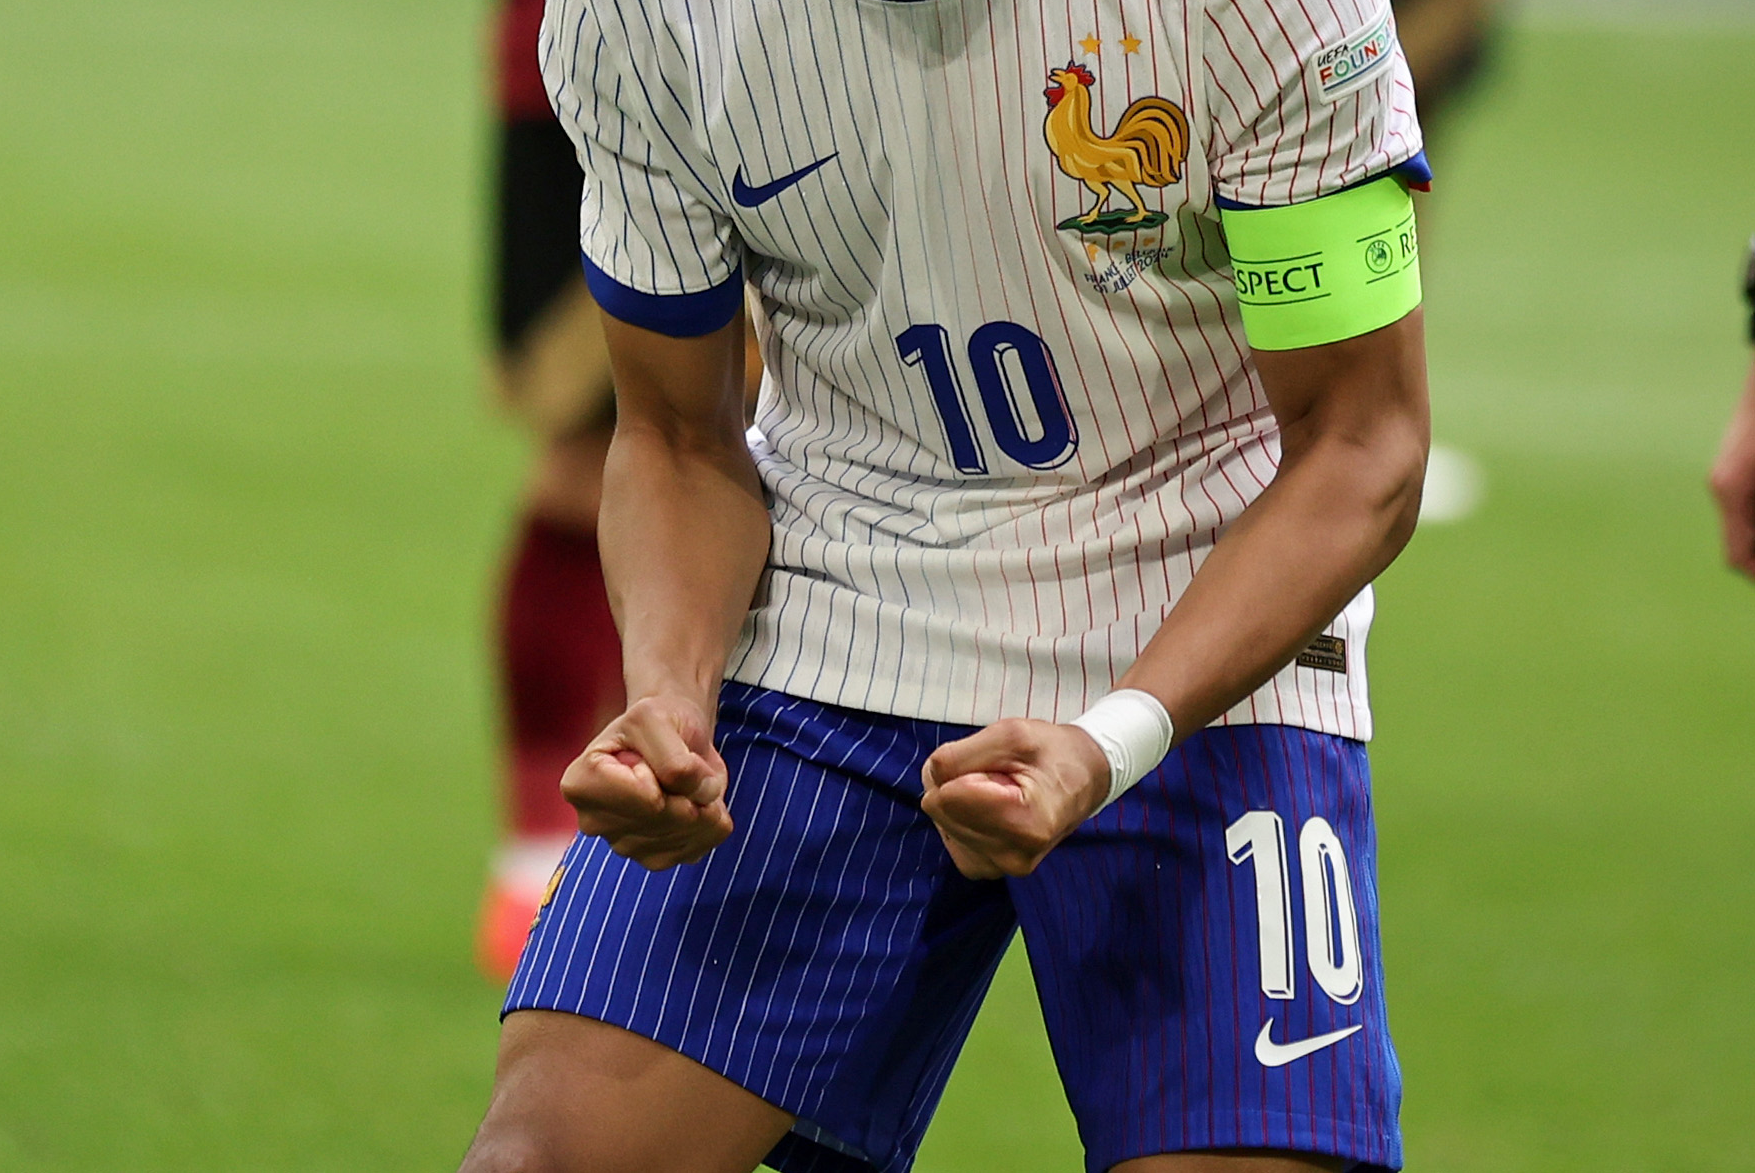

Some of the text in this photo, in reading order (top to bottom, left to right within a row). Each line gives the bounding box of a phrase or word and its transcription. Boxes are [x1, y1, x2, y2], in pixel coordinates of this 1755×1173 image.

[1317, 44, 1349, 67] UEFA
[1233, 262, 1324, 296] SPECT
[895, 321, 1079, 476] 10
[1226, 810, 1364, 1005] 10
